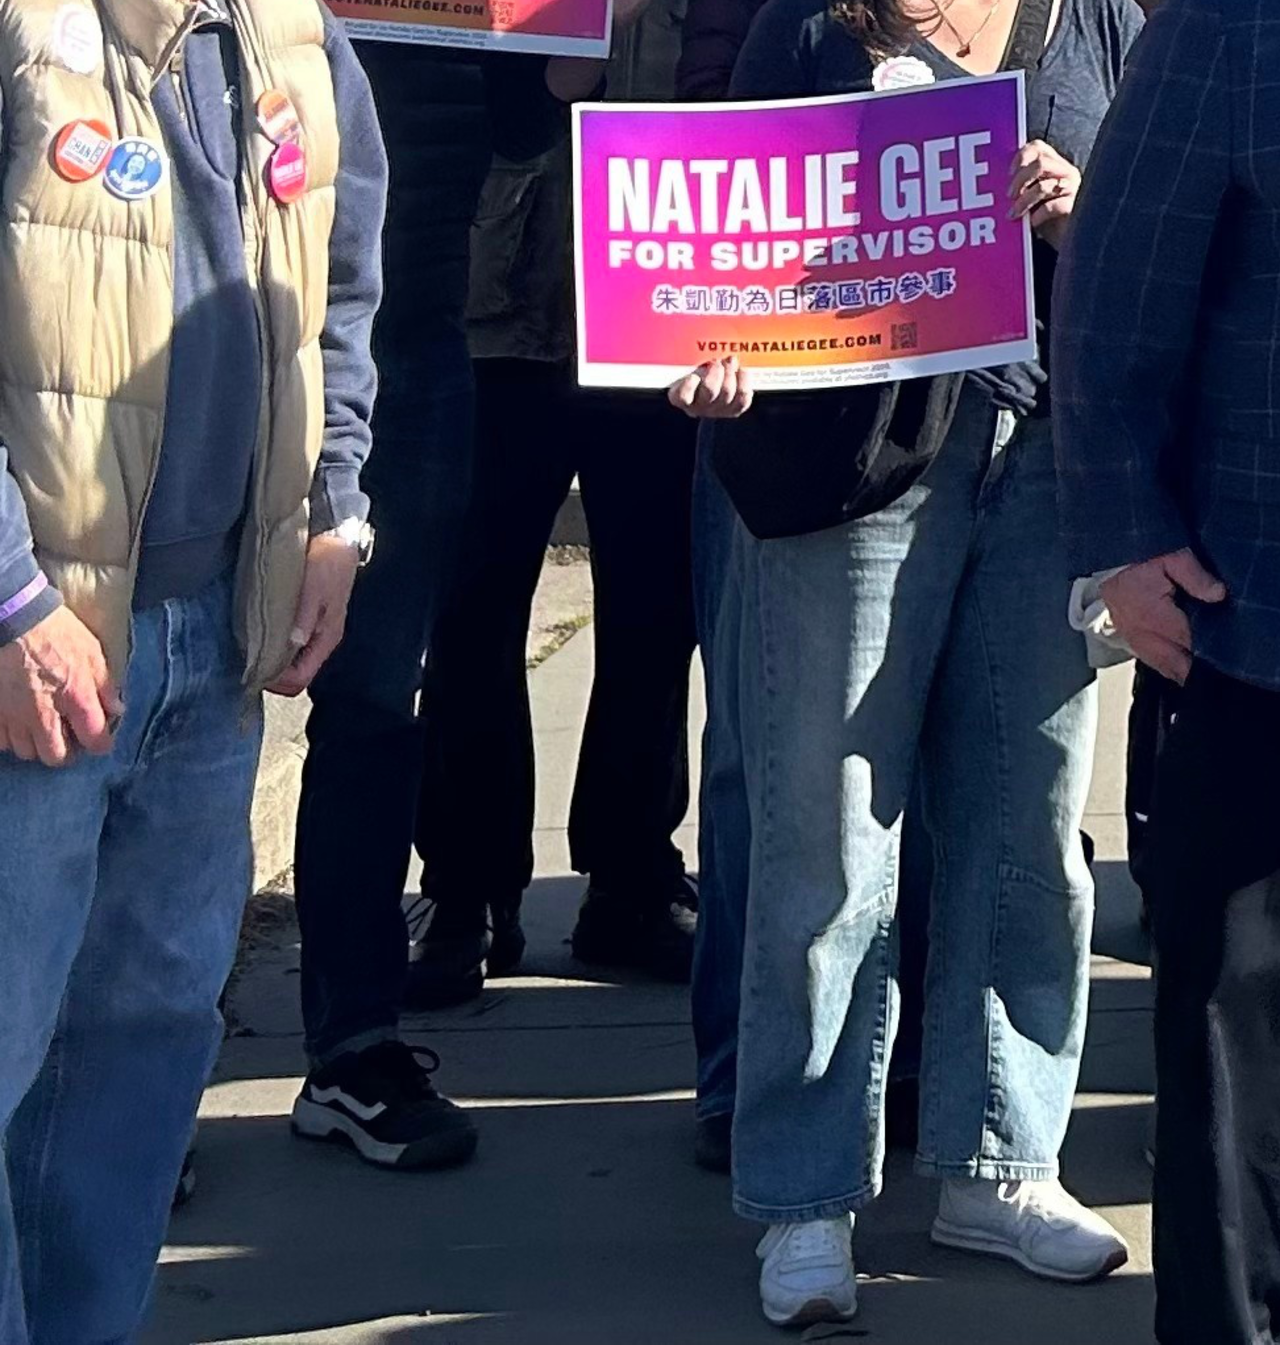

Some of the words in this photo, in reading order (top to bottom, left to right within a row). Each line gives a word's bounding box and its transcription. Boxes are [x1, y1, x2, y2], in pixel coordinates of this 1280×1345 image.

[607, 149, 861, 235] NATALIE
[879, 130, 995, 223] GEE
[608, 239, 694, 271] FOR
[711, 215, 996, 272] SUPERVISOR
[697, 333, 882, 353] VOTENATALIEGEE.COM
